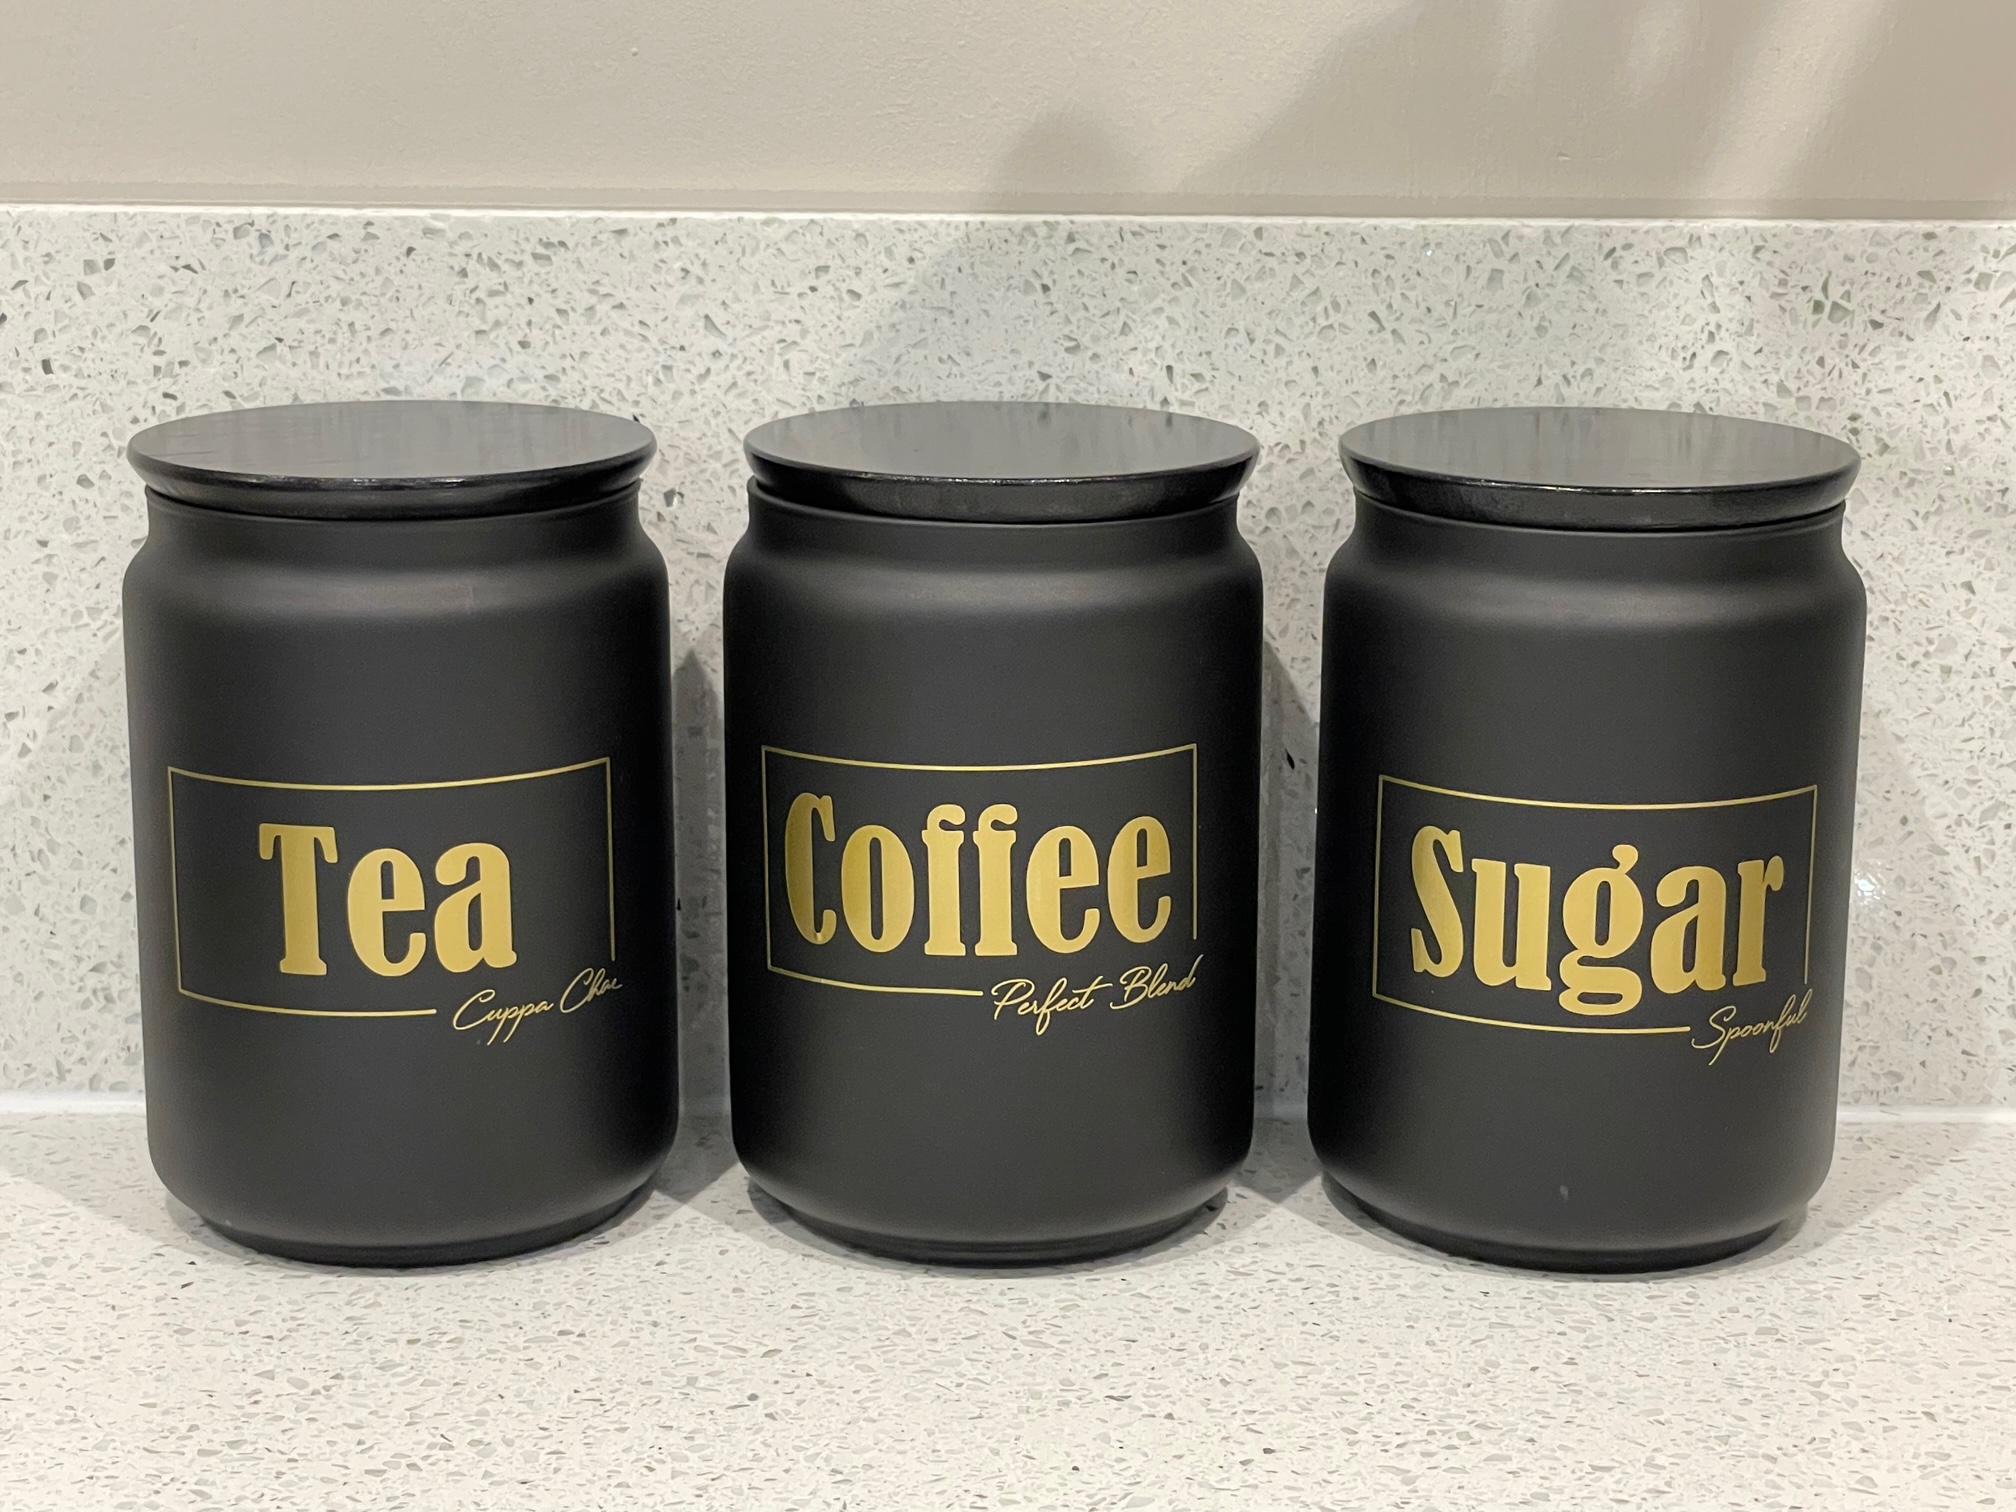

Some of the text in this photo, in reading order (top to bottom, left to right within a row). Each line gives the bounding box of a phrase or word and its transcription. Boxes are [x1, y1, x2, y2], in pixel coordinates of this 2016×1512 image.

[258, 822, 517, 978] Tea
[784, 791, 1173, 957] Coffee
[1410, 825, 1785, 1016] Sugar
[452, 988, 554, 1046] Cuppa
[990, 953, 1204, 1036] Perfect Blend
[1690, 987, 1814, 1067] Spoonful
